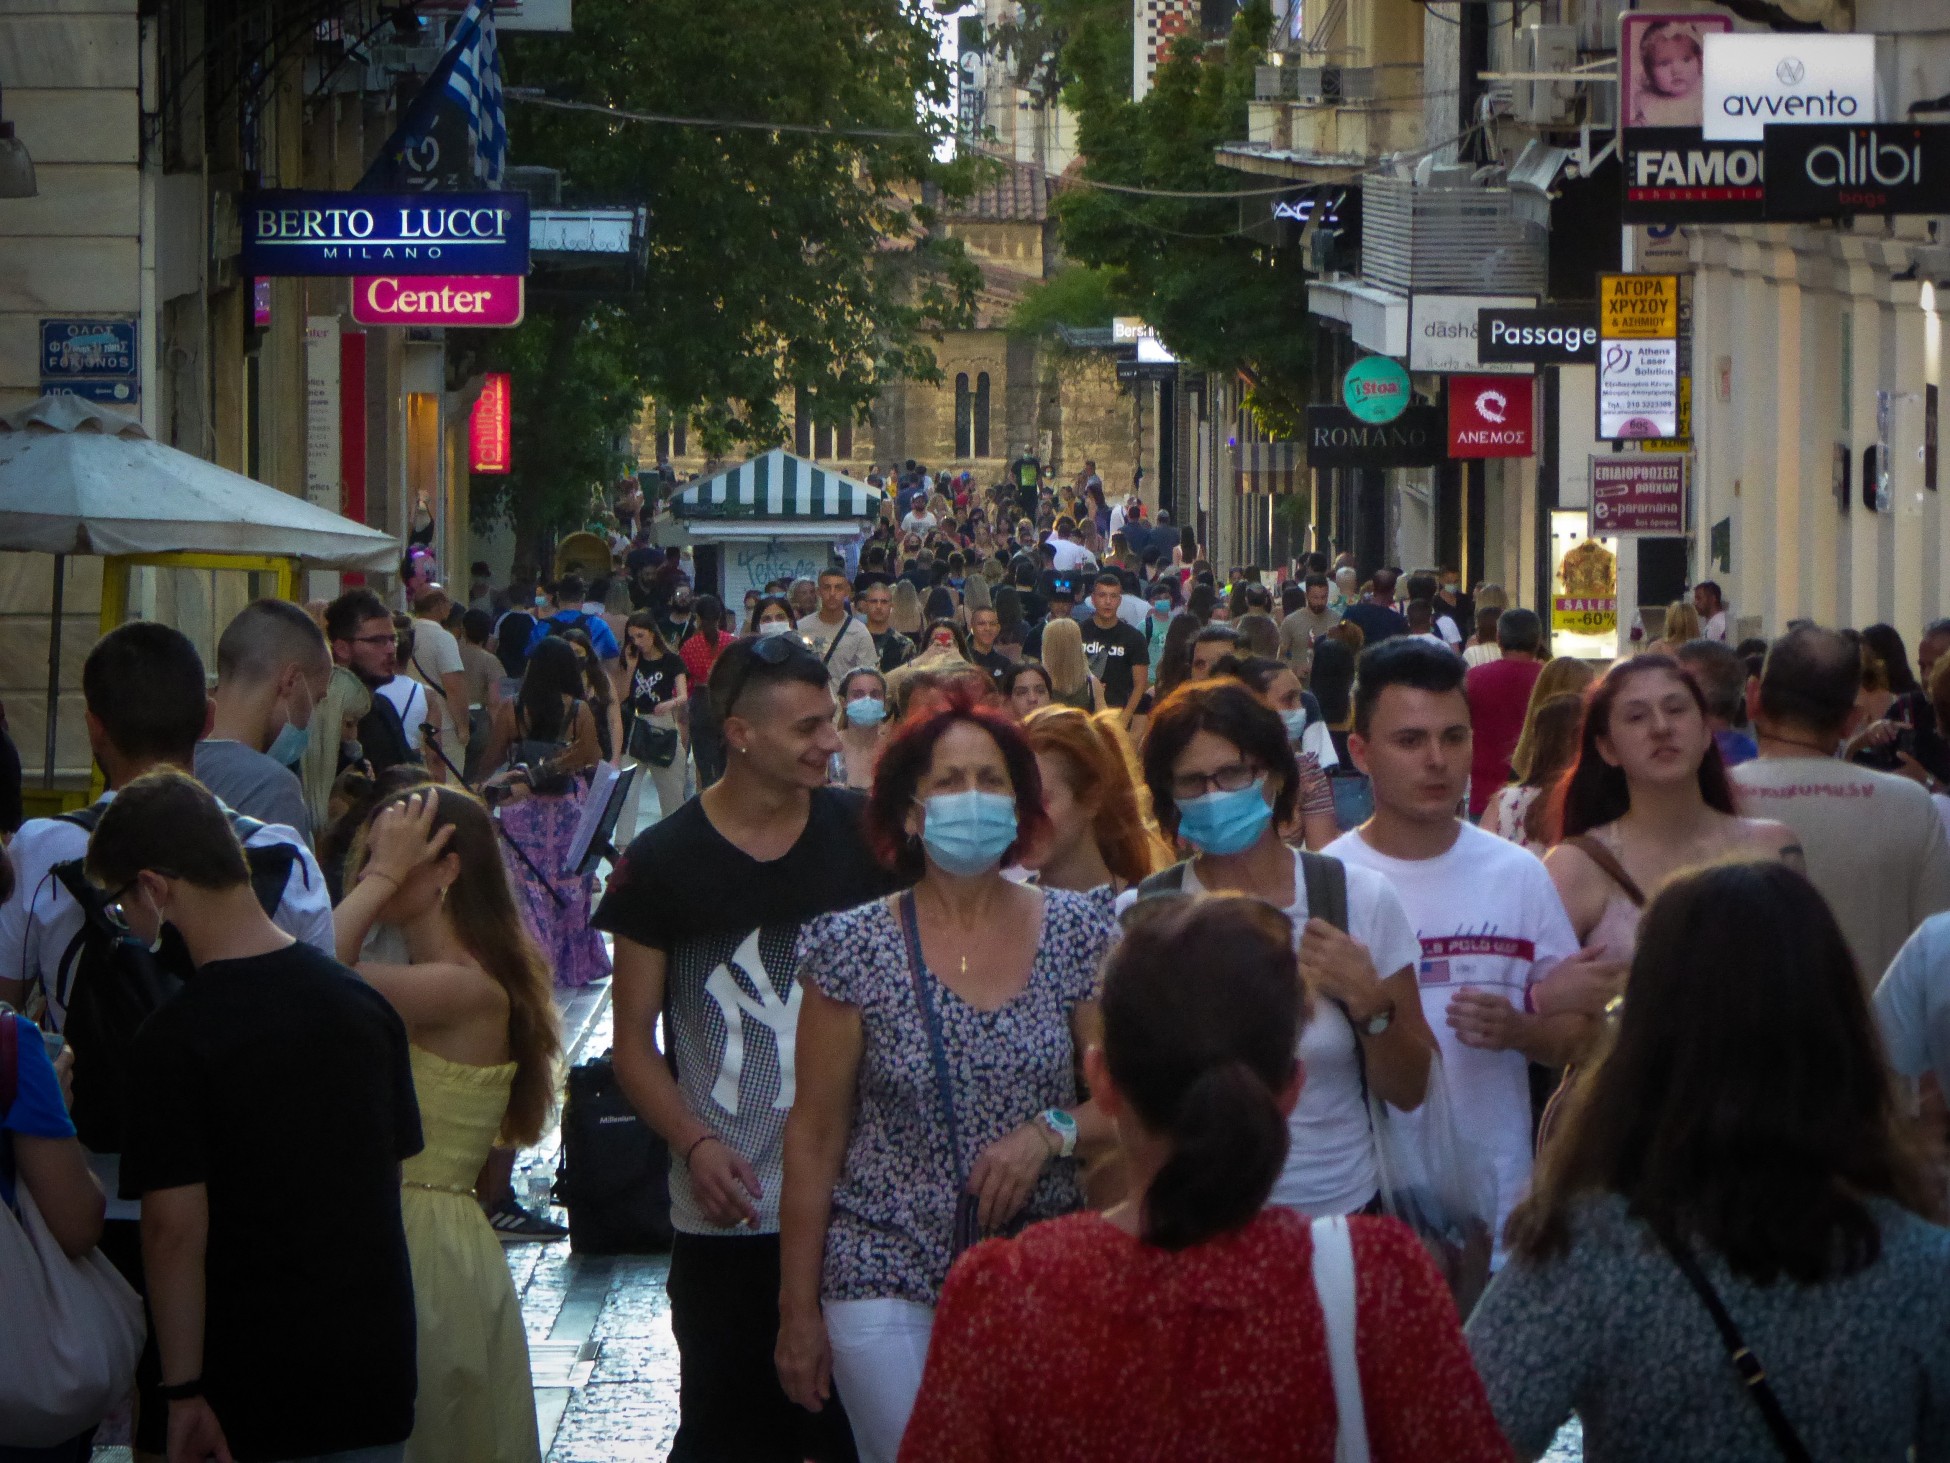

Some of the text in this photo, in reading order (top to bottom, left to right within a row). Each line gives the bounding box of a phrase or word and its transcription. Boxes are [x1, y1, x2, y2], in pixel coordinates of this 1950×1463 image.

[1723, 90, 1858, 117] avvento
[1805, 129, 1921, 186] alibi
[256, 208, 507, 238] BERTO LUCCI
[323, 247, 442, 260] MILANO
[367, 278, 492, 314] Center
[1614, 281, 1664, 296] ΑΓΟΡΑ
[1609, 298, 1669, 314] ΧΡΥΣΟΥ
[1491, 319, 1597, 352] Passage
[1637, 347, 1671, 355] Athens
[1313, 426, 1427, 448] ROMANO
[1457, 431, 1526, 445] ΑΝΕΜΟΣ
